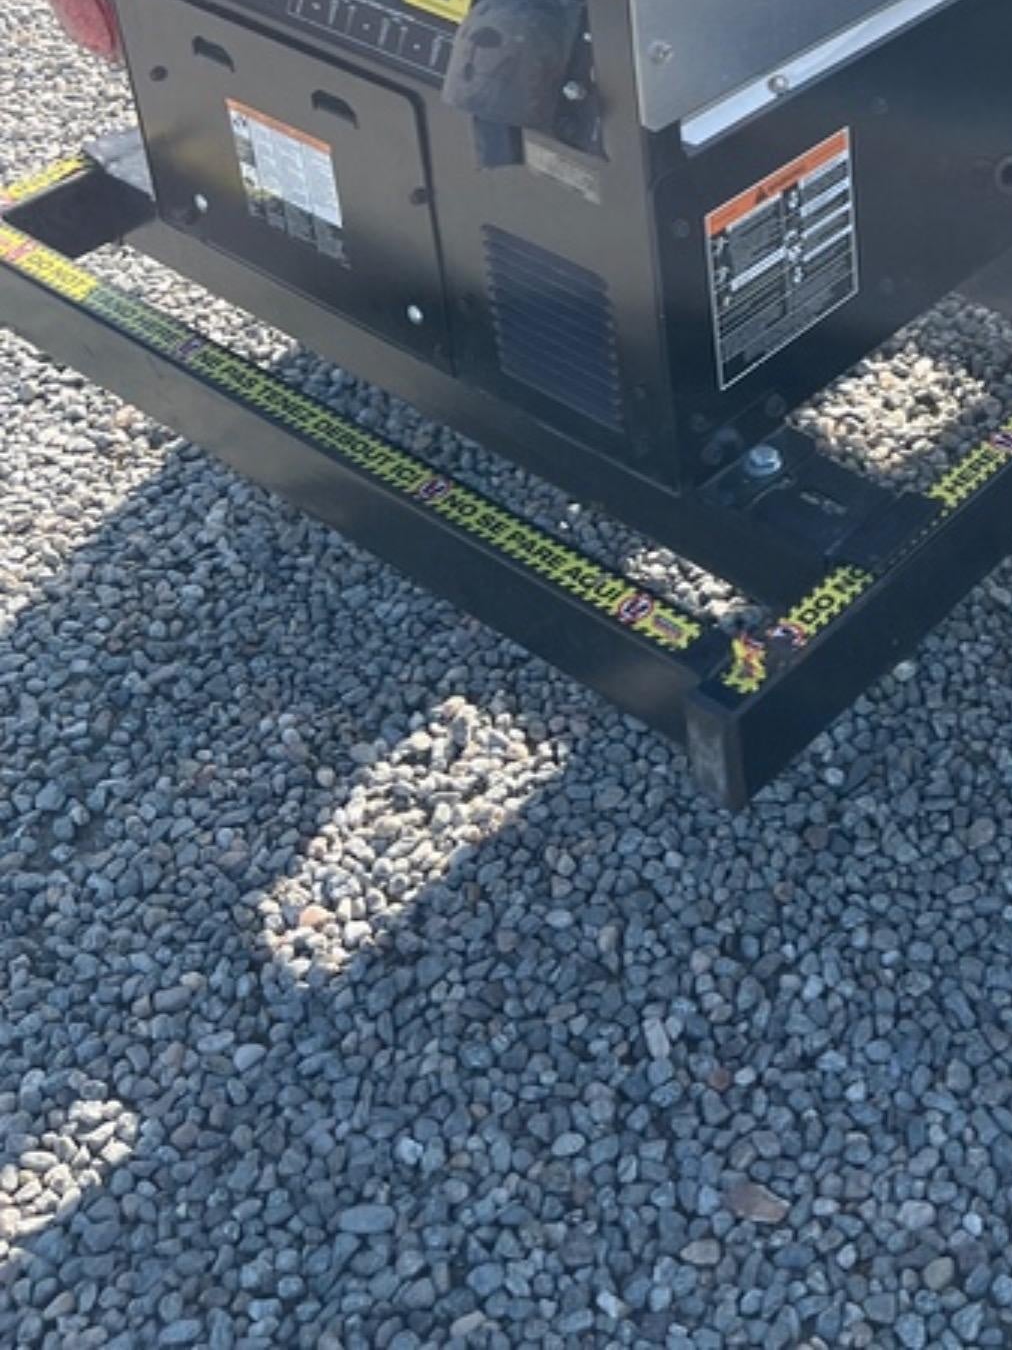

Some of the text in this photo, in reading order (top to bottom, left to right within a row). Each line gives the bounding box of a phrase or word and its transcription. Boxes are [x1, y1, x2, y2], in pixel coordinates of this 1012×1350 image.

[442, 492, 478, 517] NO
[475, 510, 509, 535] SE
[504, 525, 567, 569] PARE
[801, 595, 836, 624] DO
